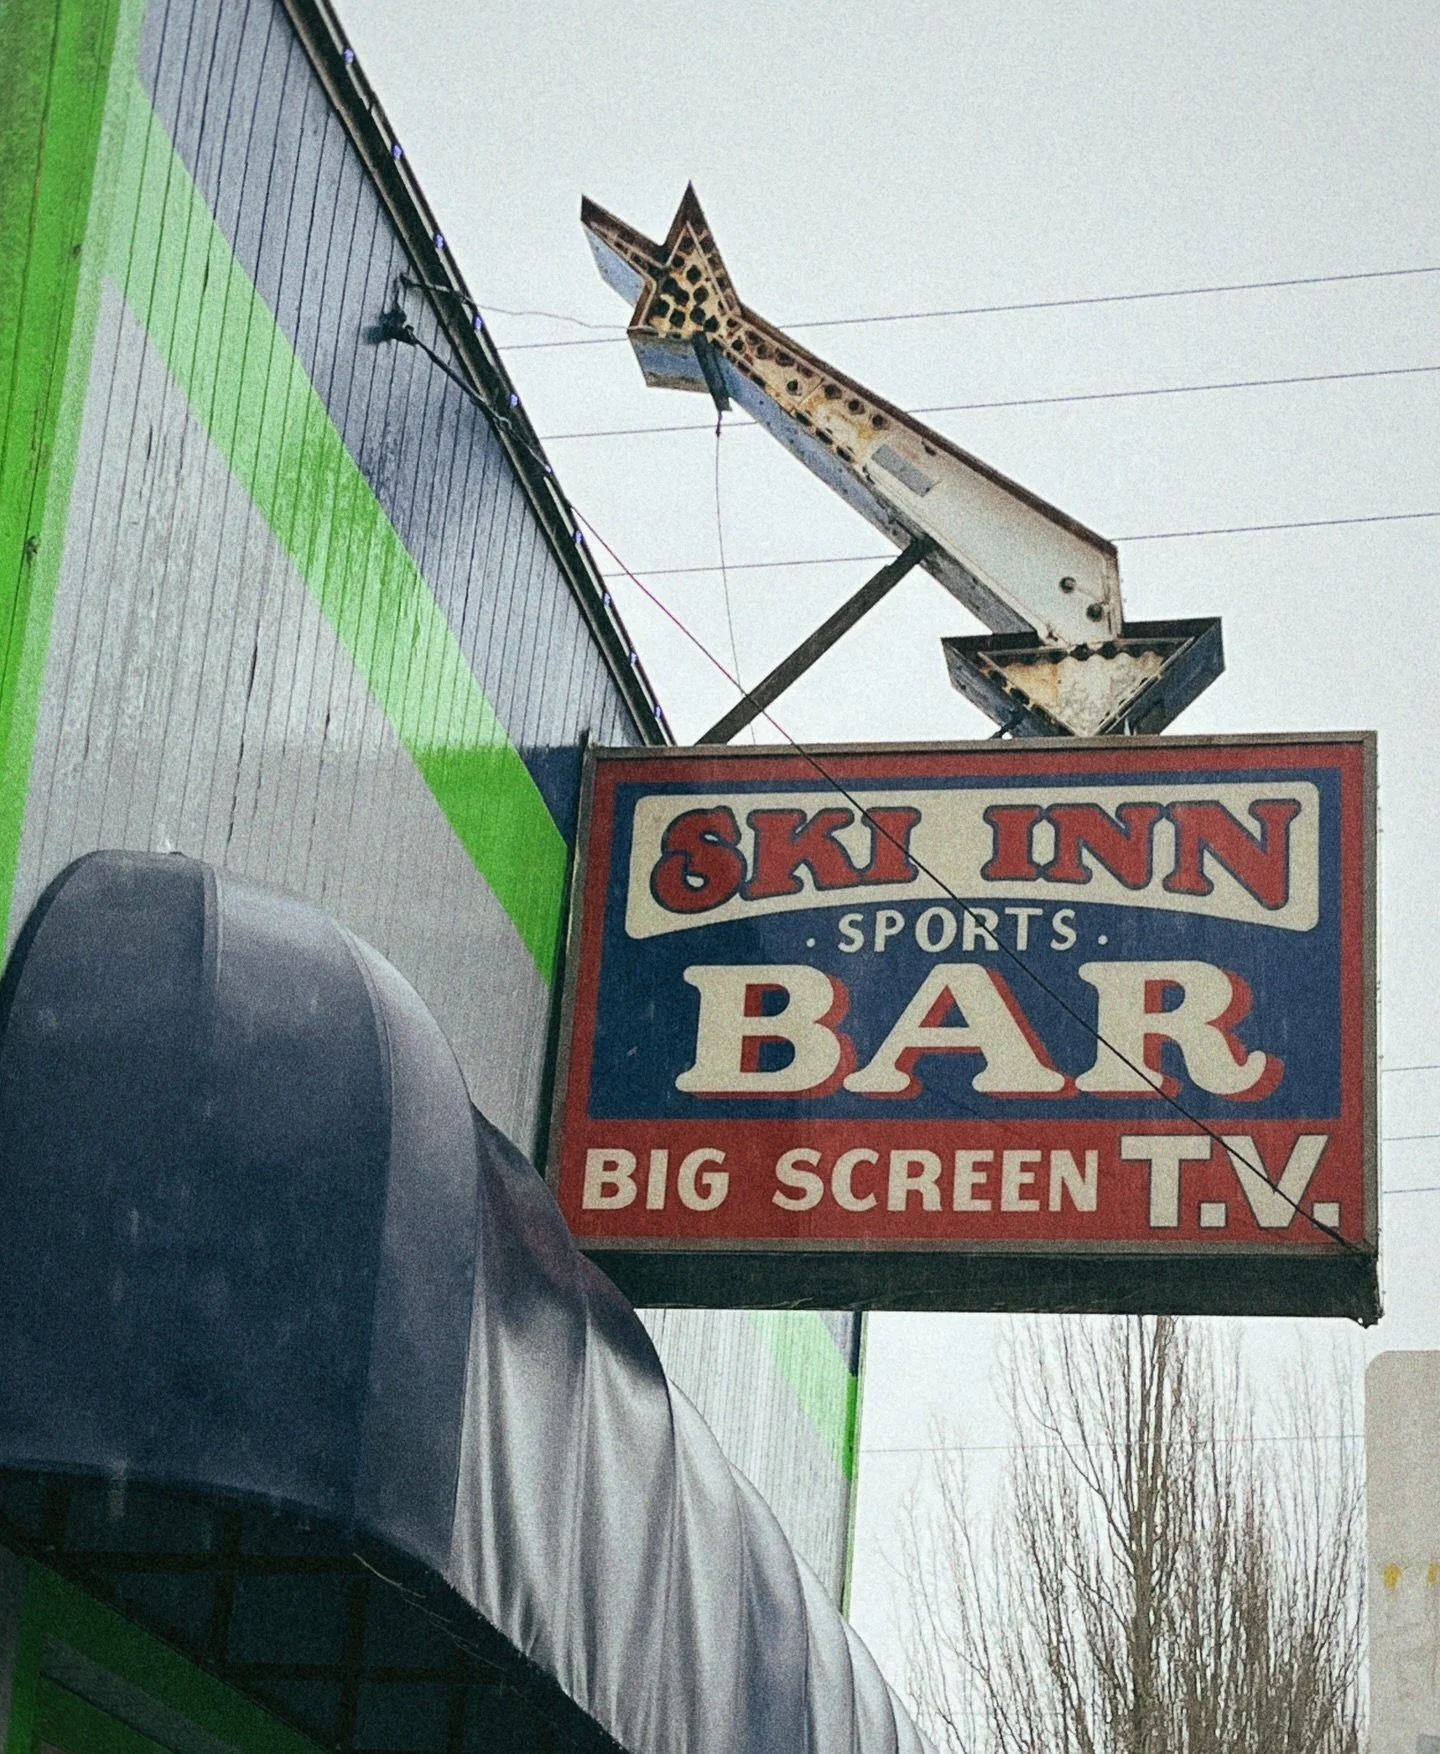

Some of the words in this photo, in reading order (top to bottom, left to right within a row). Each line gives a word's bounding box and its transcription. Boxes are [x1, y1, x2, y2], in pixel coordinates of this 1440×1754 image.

[650, 806, 921, 914] SKI
[980, 798, 1302, 911] INN
[838, 906, 1077, 954] SPORTS
[675, 960, 1284, 1102] BAR
[581, 1146, 730, 1212] BIG
[771, 1146, 1099, 1213] SCREEN
[1119, 1133, 1341, 1229] T.V.
